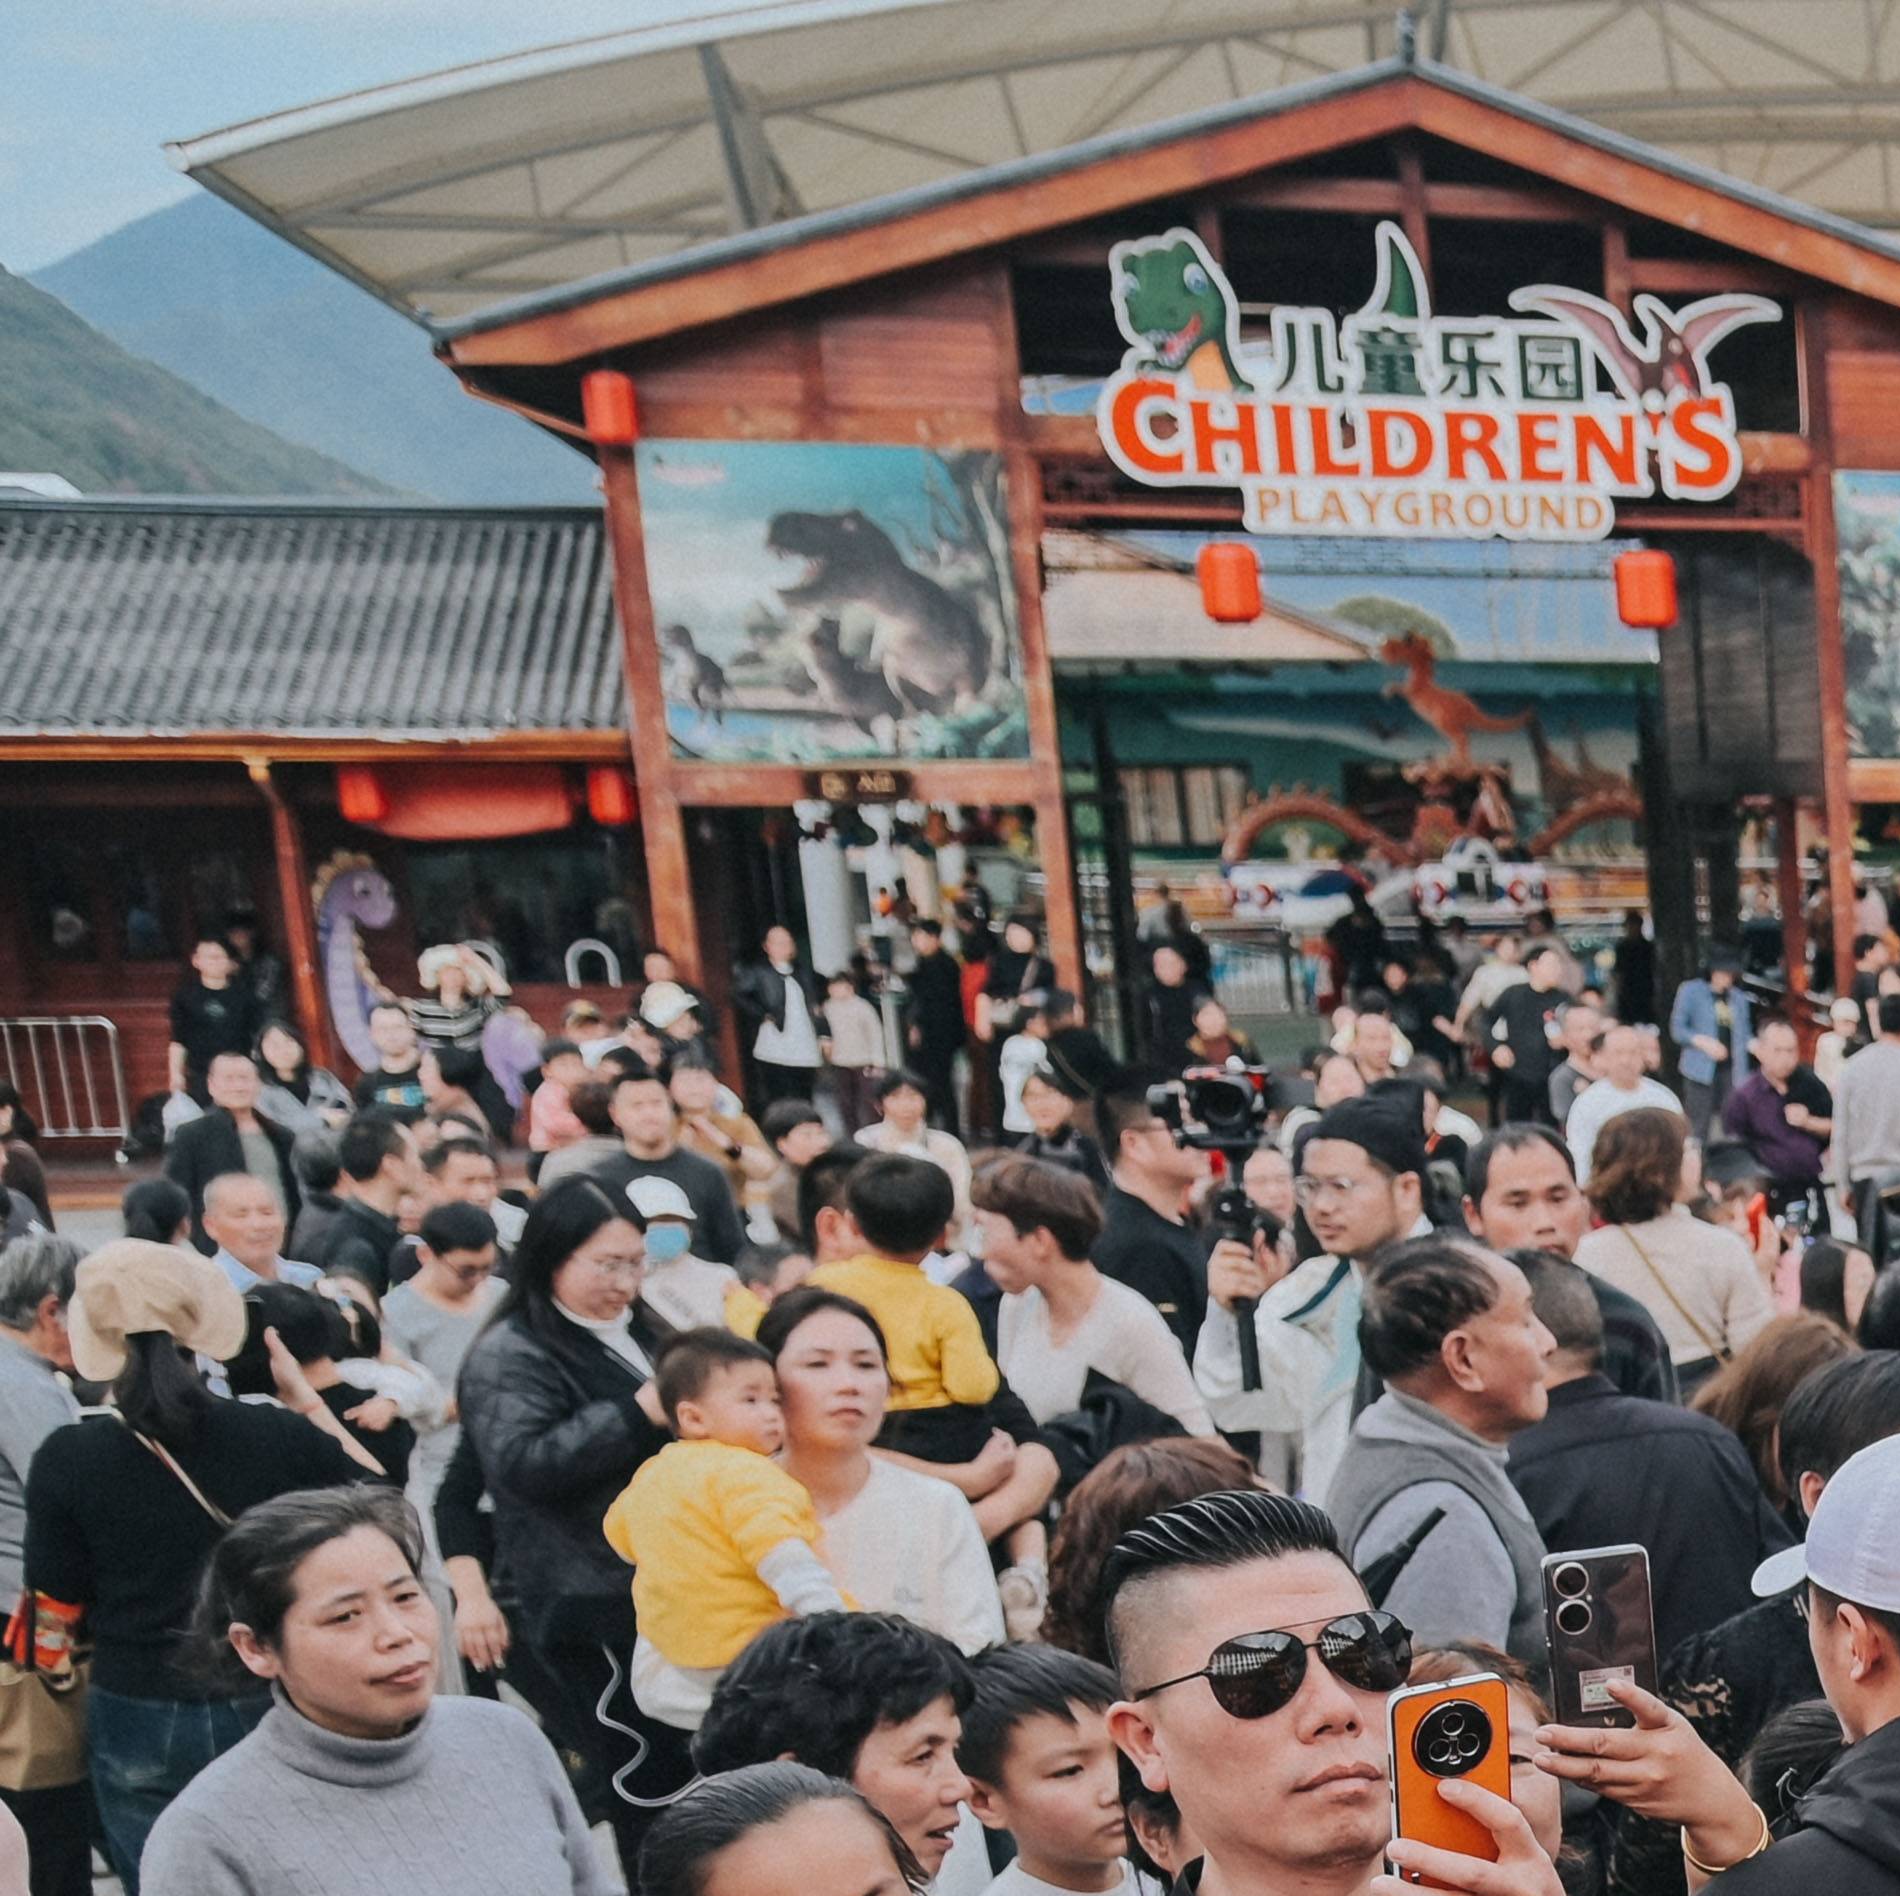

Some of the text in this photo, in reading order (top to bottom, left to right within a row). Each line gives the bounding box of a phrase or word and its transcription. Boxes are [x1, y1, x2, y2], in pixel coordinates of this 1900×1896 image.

[1275, 322, 1583, 400] 儿童乐园
[1112, 381, 1731, 488] CHILDREN'S
[1258, 489, 1604, 530] PLAYGROUND
